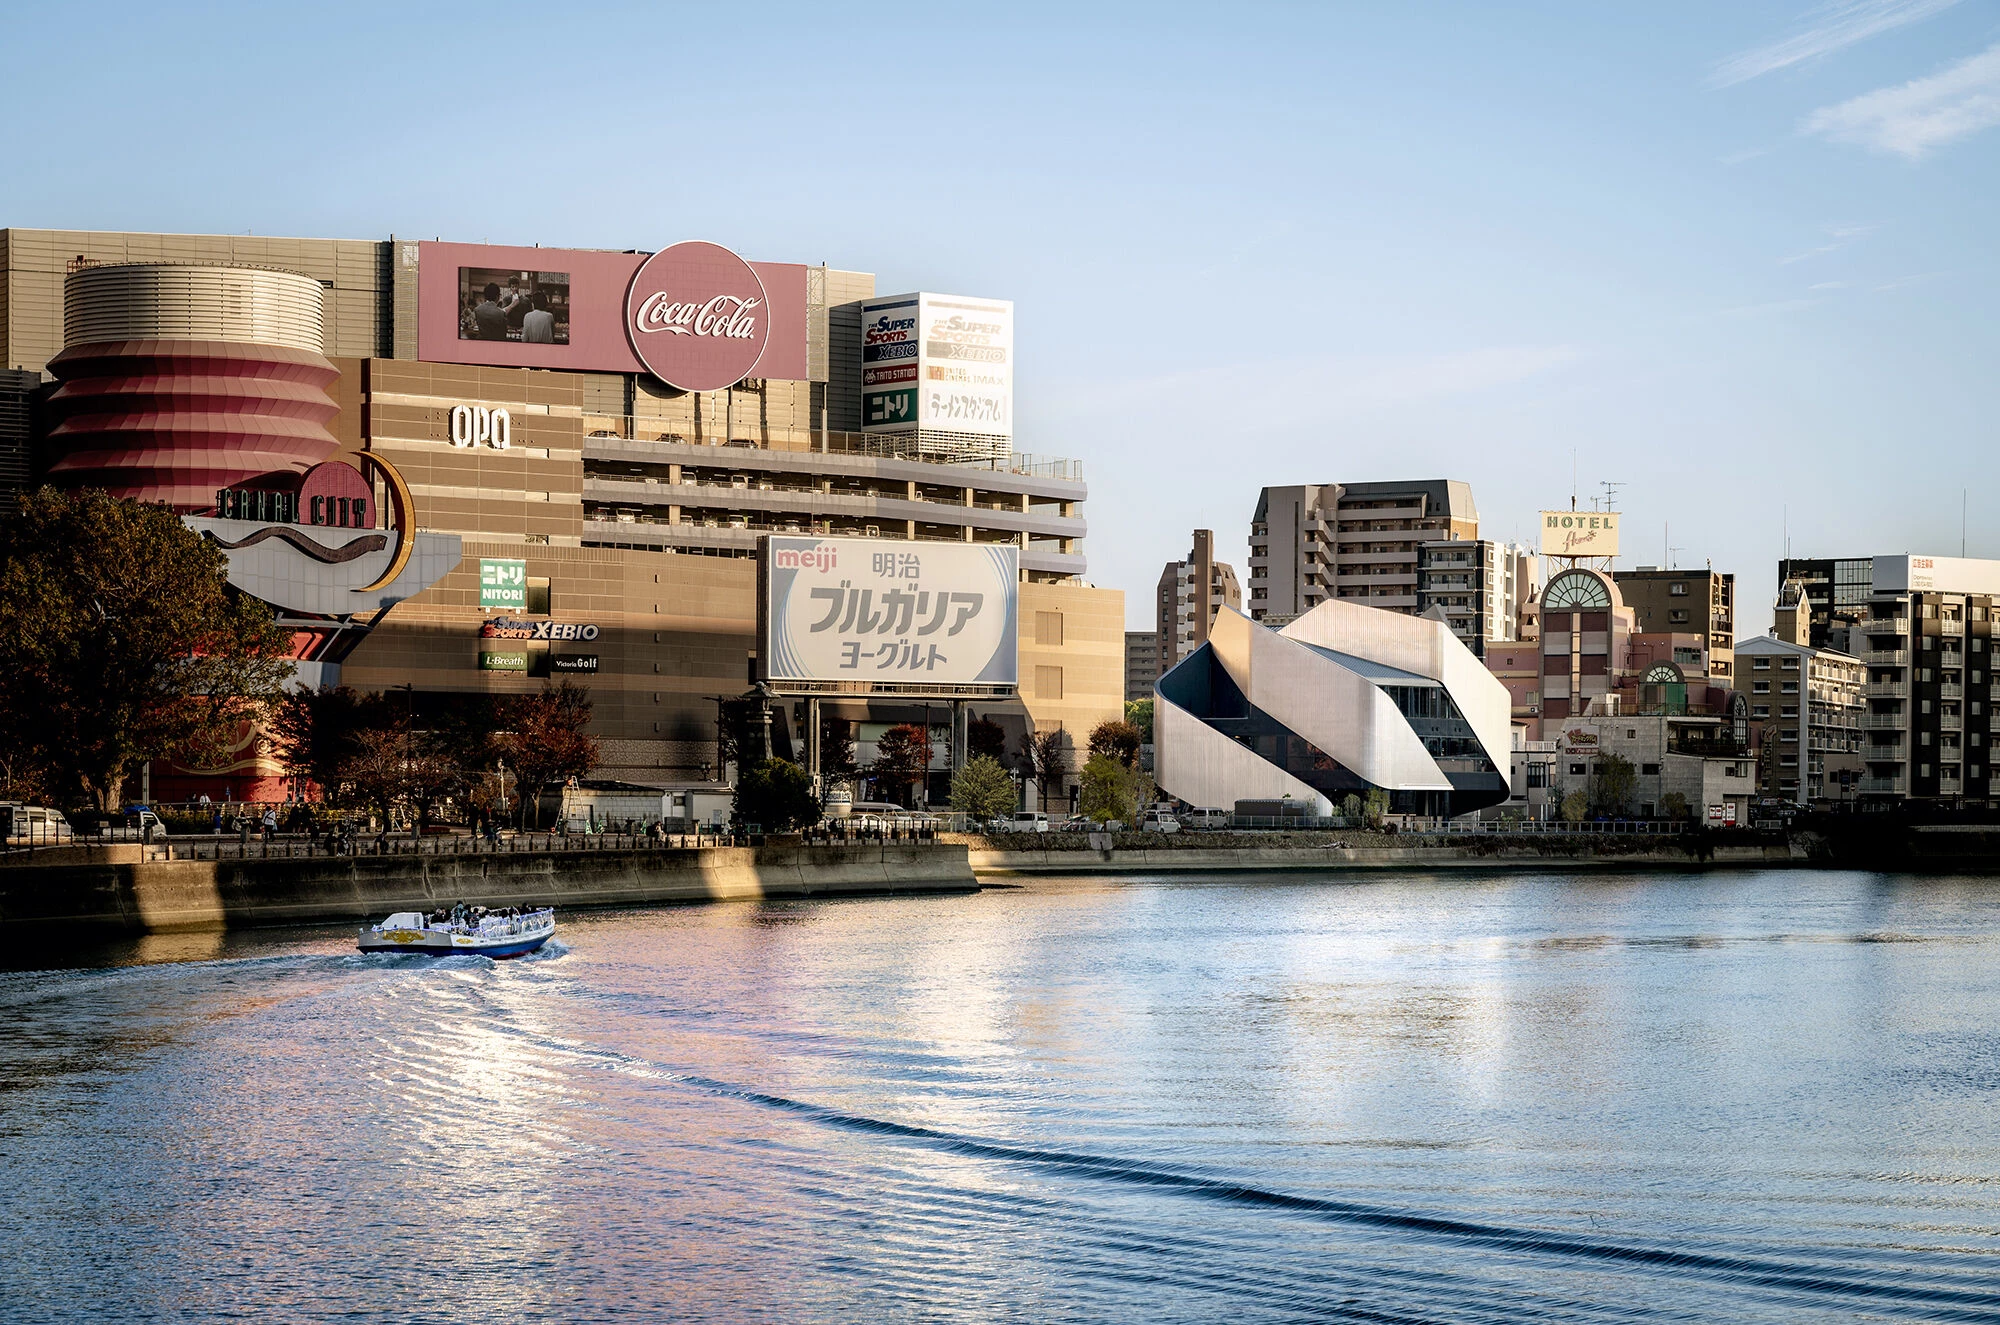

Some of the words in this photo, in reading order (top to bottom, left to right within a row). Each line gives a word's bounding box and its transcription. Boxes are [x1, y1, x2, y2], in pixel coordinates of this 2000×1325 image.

[877, 316, 915, 332] SUPER
[948, 316, 1002, 335] SUPER
[865, 329, 908, 345] SPORTS
[929, 325, 991, 344] SPORTS
[879, 343, 917, 360] XEBIO
[949, 344, 1006, 363] XEBIO
[876, 371, 892, 381] TAITO
[893, 367, 916, 379] STATION
[973, 375, 1004, 386] IMAX
[871, 394, 909, 421] ニトリ
[224, 488, 299, 523] CANAL
[313, 495, 366, 528] CITY
[1547, 516, 1613, 529] HOTEL
[777, 546, 837, 574] meiji
[872, 552, 920, 579] 明治
[482, 565, 523, 586] ニトリ
[482, 589, 523, 600] NITORI
[810, 579, 983, 637] ブルガリア
[483, 624, 533, 639] SPORTS
[533, 621, 599, 640] XEBIO
[486, 656, 523, 666] L-Breath
[556, 660, 577, 668] Victoria
[577, 658, 597, 668] Golf
[839, 639, 947, 671] ヨーグルト
